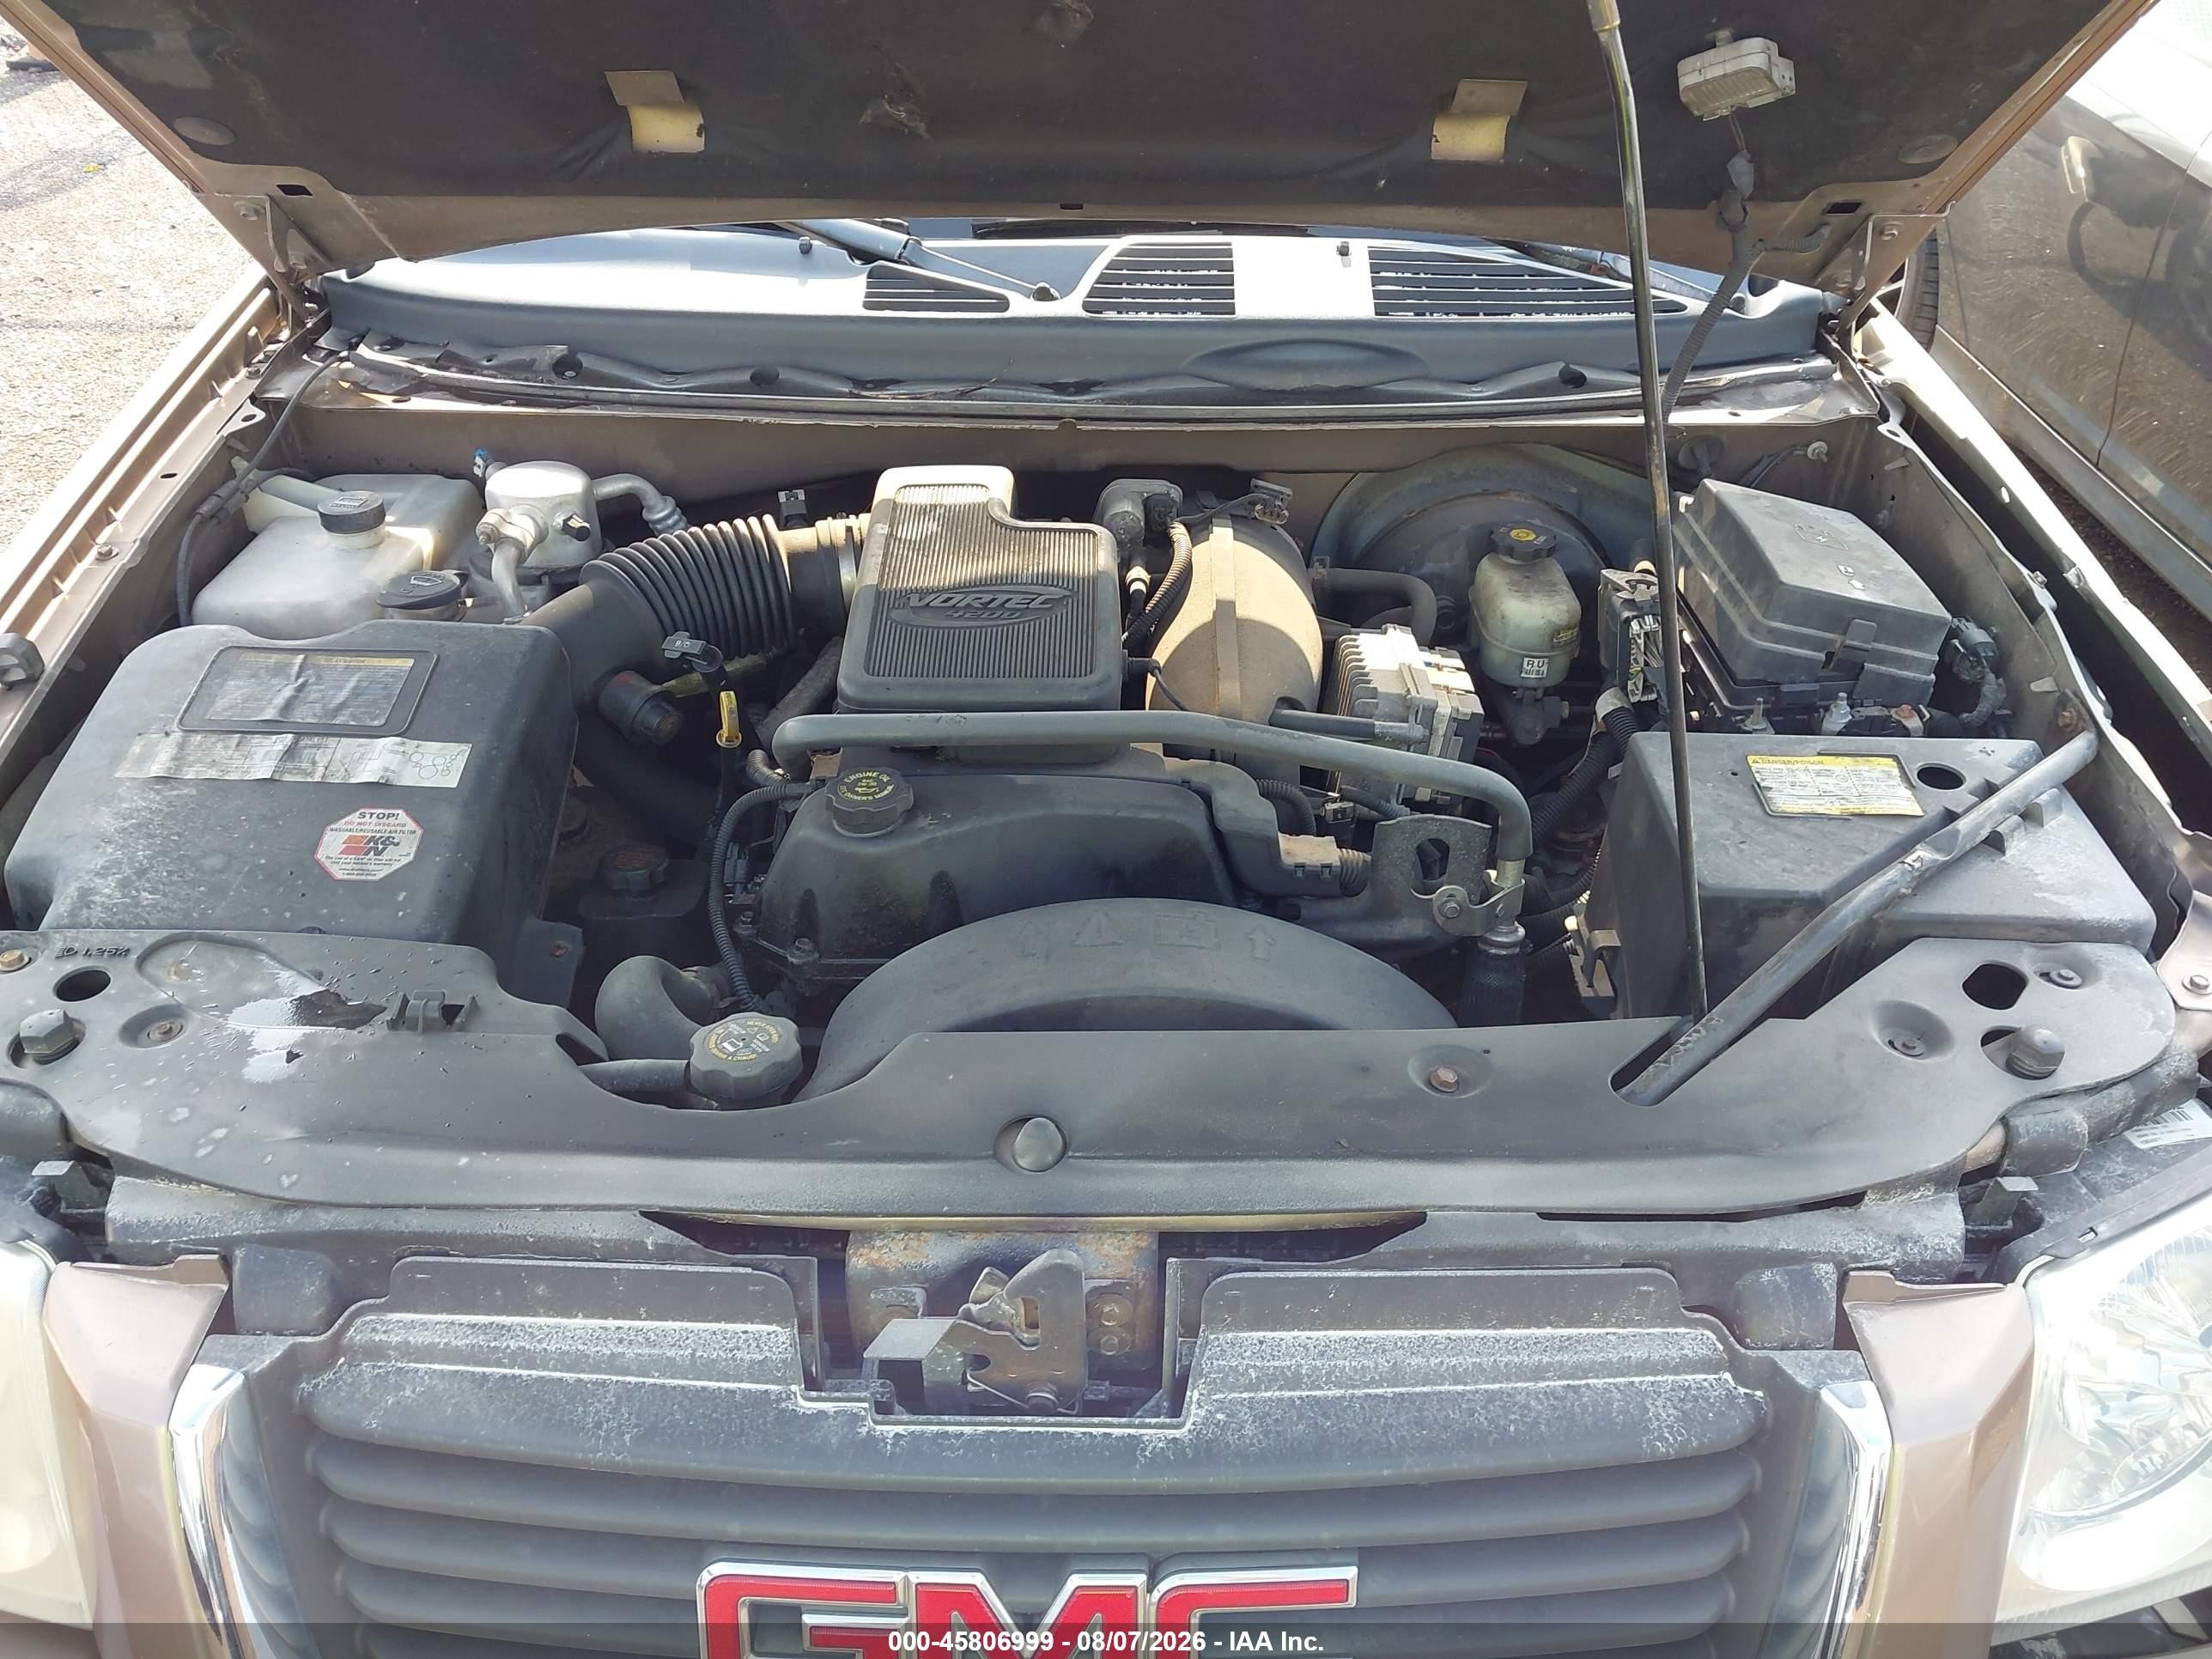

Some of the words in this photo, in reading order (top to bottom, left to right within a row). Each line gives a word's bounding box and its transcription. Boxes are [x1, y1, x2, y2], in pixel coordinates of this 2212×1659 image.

[907, 592, 1067, 609] VORTEC
[945, 610, 1022, 620] 4200
[843, 771, 879, 783] ENGINE
[878, 774, 891, 783] OIL
[357, 811, 399, 820] STOP!
